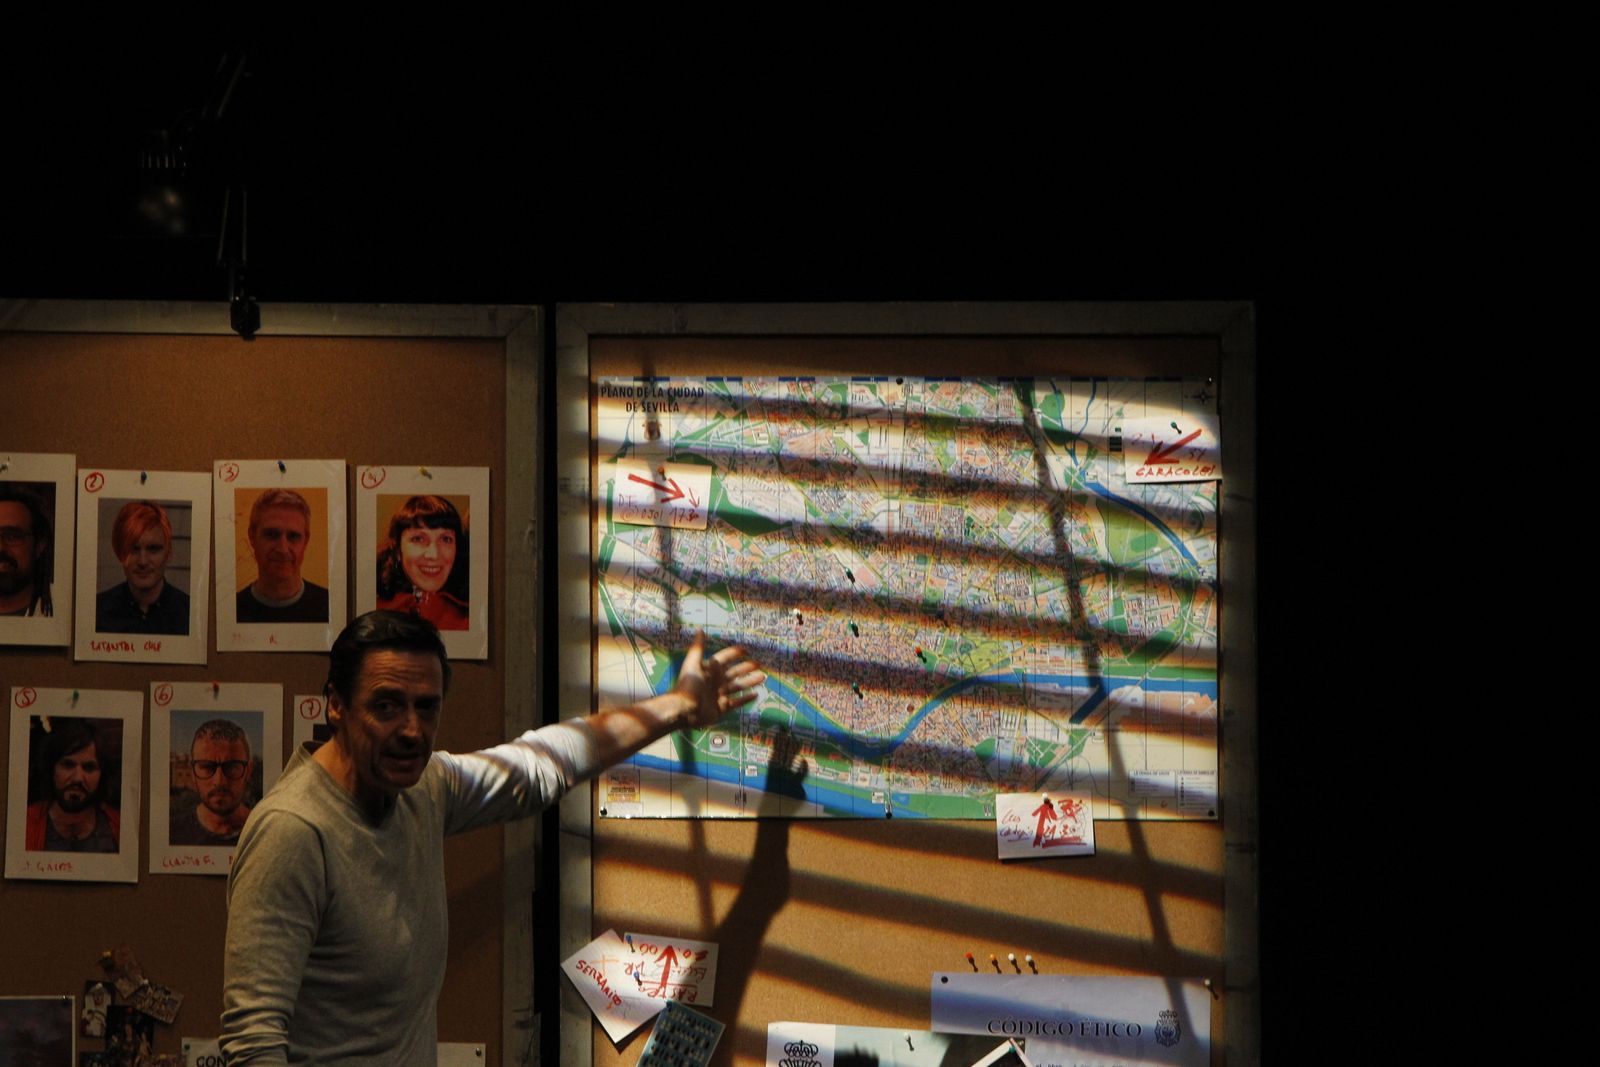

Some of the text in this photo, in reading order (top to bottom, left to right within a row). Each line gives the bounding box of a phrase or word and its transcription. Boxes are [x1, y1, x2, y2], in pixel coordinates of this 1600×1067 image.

[601, 386, 704, 398] PLANO DE LA CIUDAD
[626, 402, 680, 413] DE SEVILLA
[987, 1016, 1073, 1036] CÓDIGO
